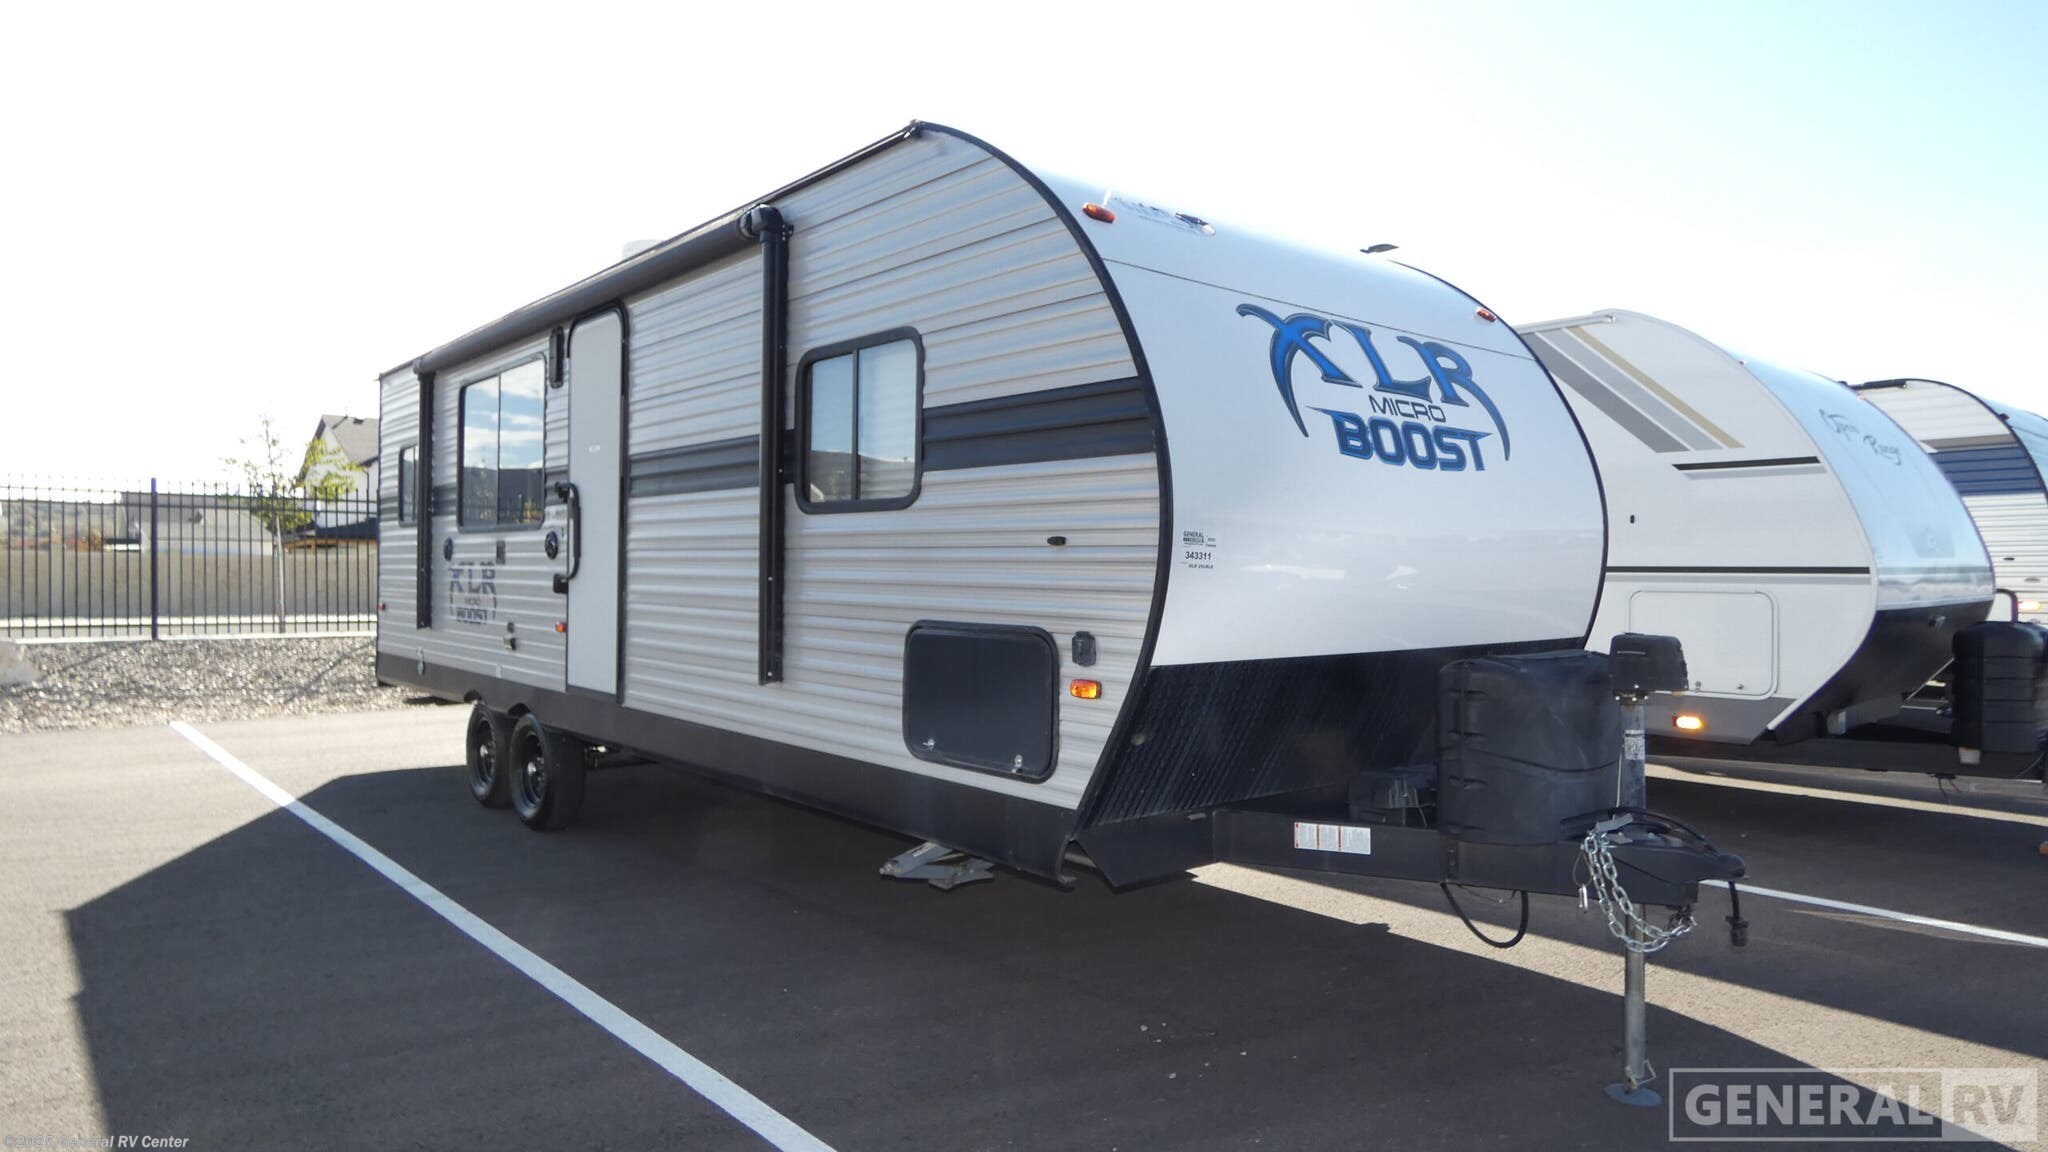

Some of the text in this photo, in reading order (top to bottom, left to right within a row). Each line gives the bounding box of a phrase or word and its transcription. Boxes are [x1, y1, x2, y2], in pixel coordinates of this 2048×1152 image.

[1236, 303, 1510, 461] XLR
[1368, 395, 1447, 423] MICRO
[1306, 406, 1493, 471] BOOST
[1185, 551, 1211, 560] 343311
